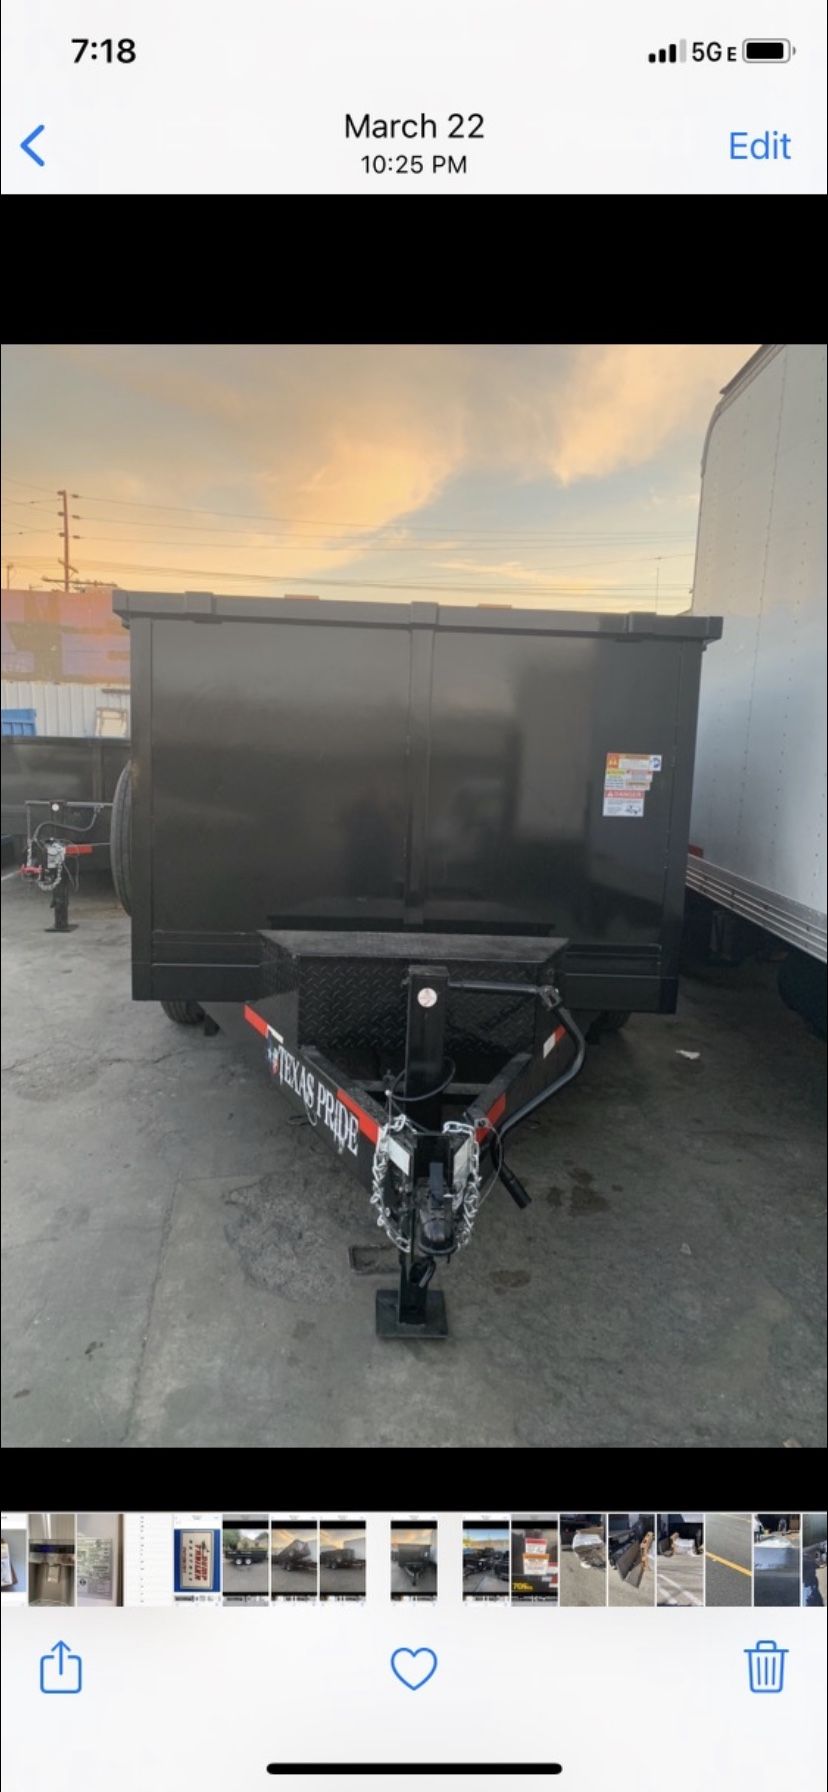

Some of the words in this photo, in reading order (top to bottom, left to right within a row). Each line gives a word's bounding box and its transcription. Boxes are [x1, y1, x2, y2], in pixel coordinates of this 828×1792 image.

[71, 38, 136, 64] 7:18
[345, 112, 437, 140] March
[447, 112, 485, 139] 22
[730, 130, 792, 160] Edit
[360, 154, 424, 175] 10:25
[432, 154, 467, 175] PM
[277, 1044, 315, 1109] TEXAS
[316, 1081, 359, 1157] PRIDE
